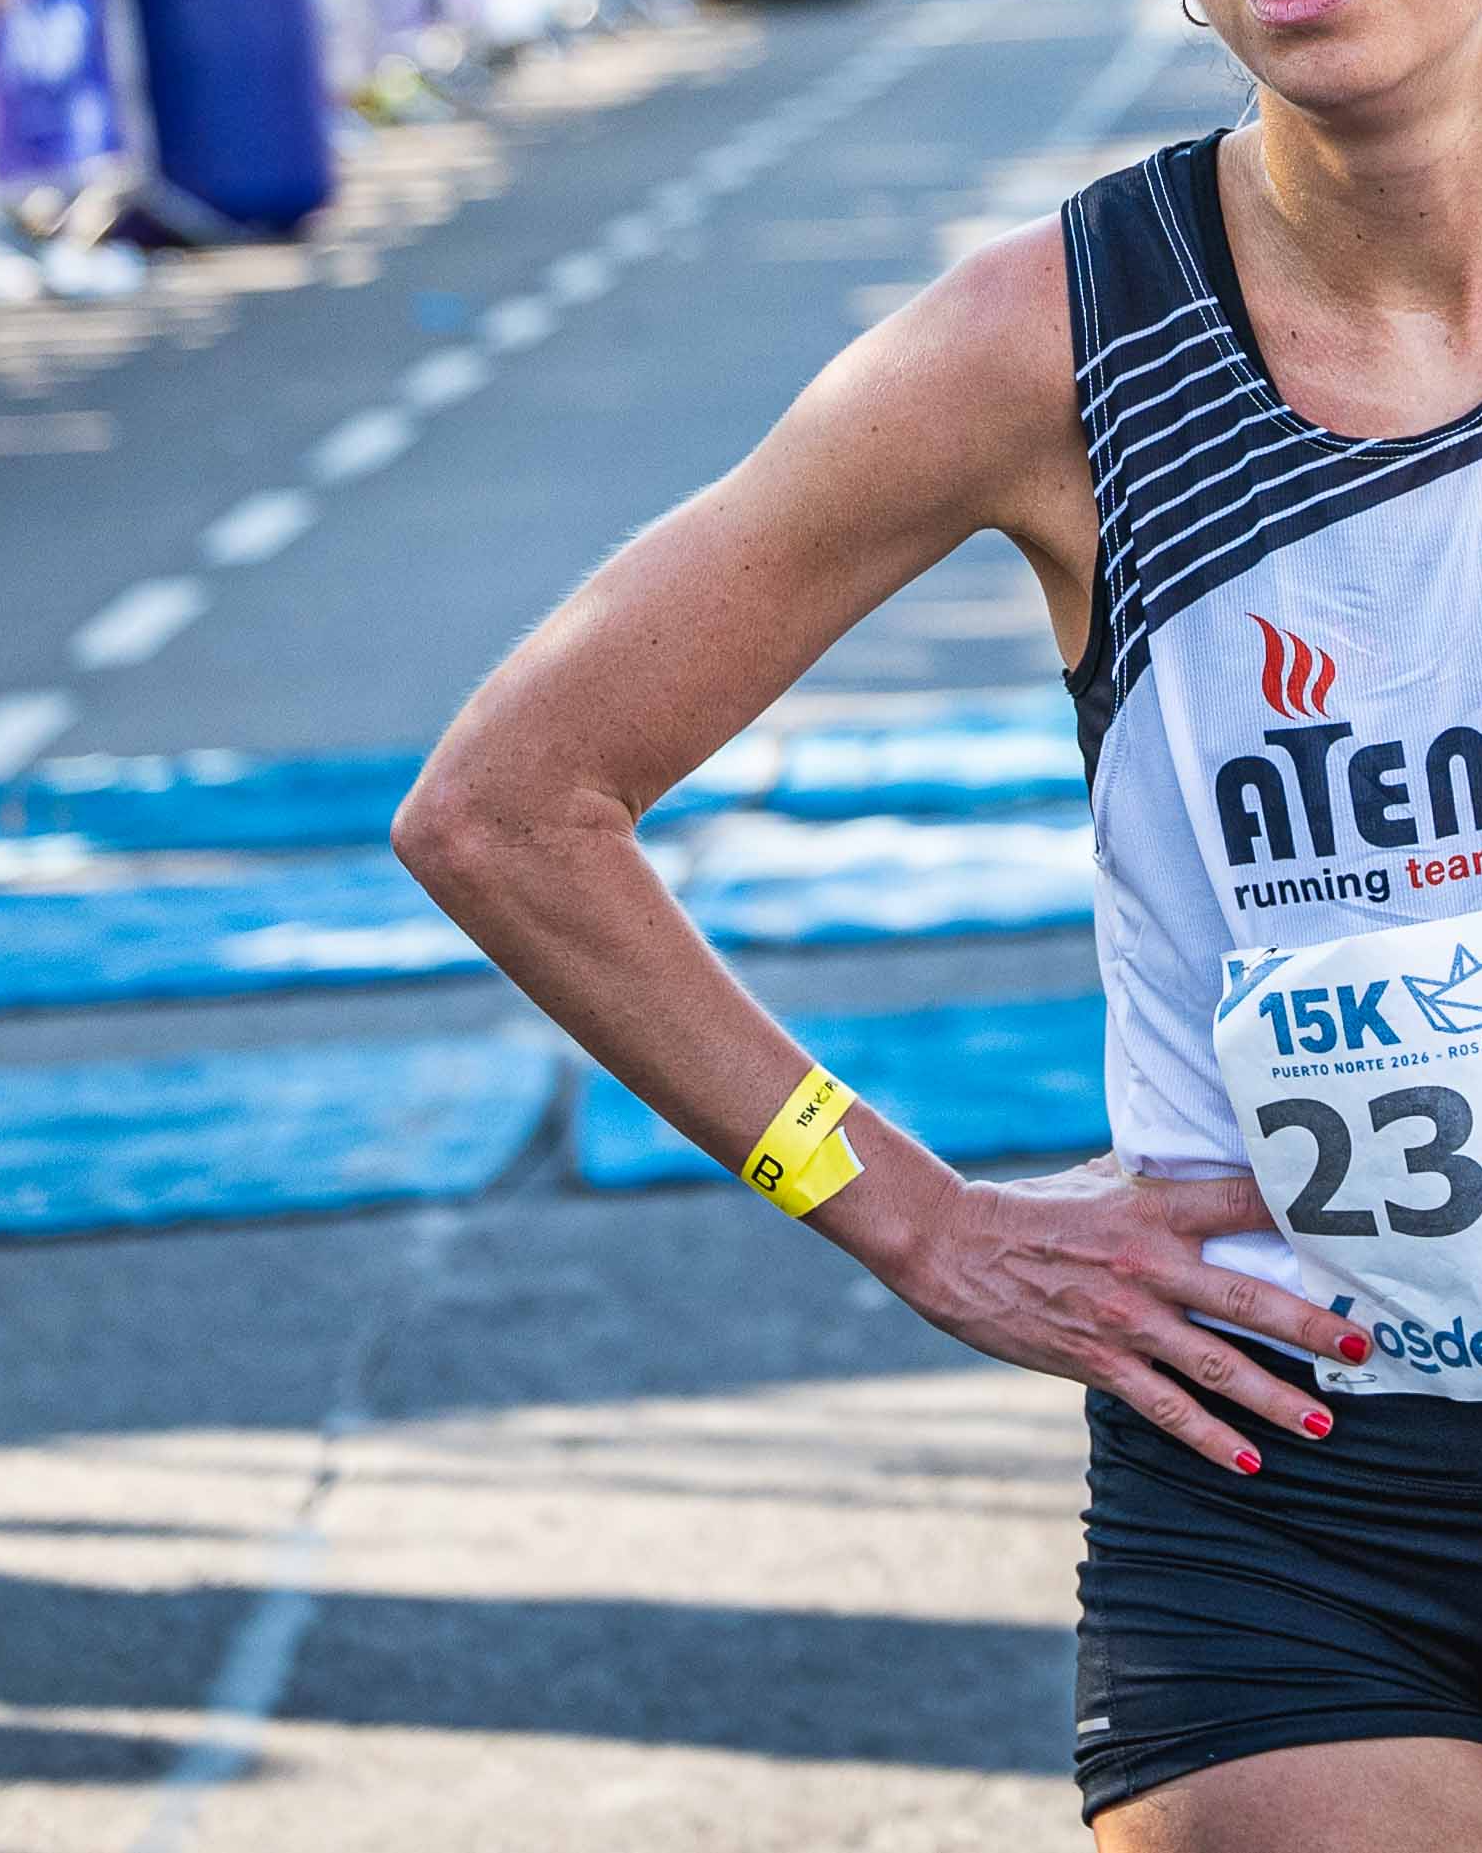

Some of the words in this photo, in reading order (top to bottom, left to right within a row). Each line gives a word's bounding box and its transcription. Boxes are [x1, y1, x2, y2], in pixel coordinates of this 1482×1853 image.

[1234, 868, 1391, 910] running
[1259, 979, 1402, 1055] 15K
[1272, 1063, 1329, 1079] PUERTO
[1334, 1058, 1384, 1075] NORTE
[1391, 1052, 1429, 1069] 2026
[796, 1102, 820, 1127] 15K
[751, 1153, 784, 1192] B
